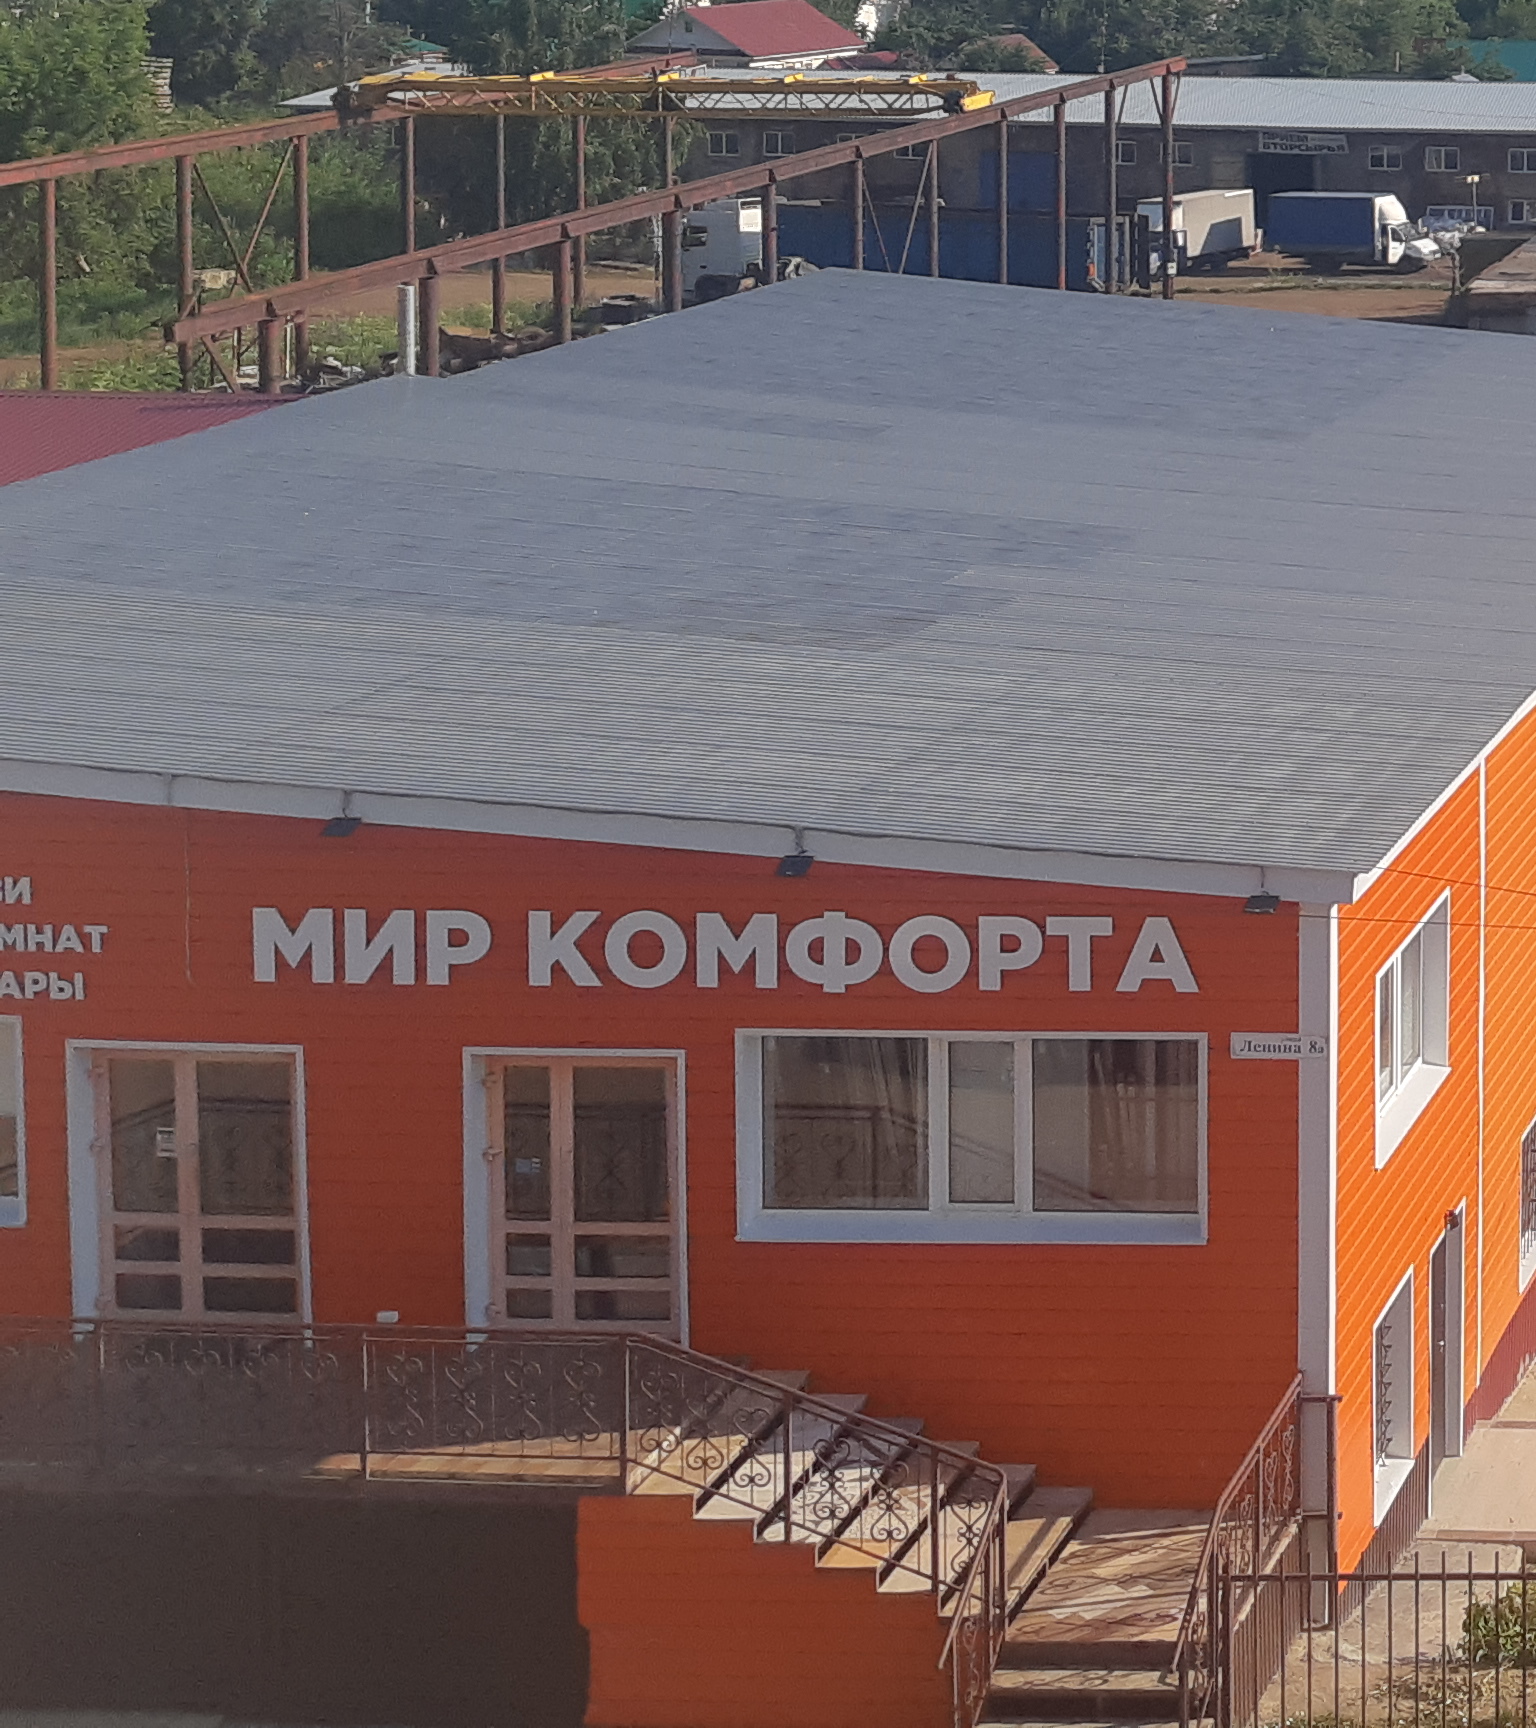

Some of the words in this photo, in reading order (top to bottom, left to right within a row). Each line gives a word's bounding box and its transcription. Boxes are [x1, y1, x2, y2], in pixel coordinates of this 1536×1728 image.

[0, 876, 32, 905] И
[252, 907, 492, 985] МИР
[528, 909, 1200, 994] КОМФОРТА
[0, 970, 85, 1001] АРЫ
[1239, 1039, 1302, 1054] Ленина
